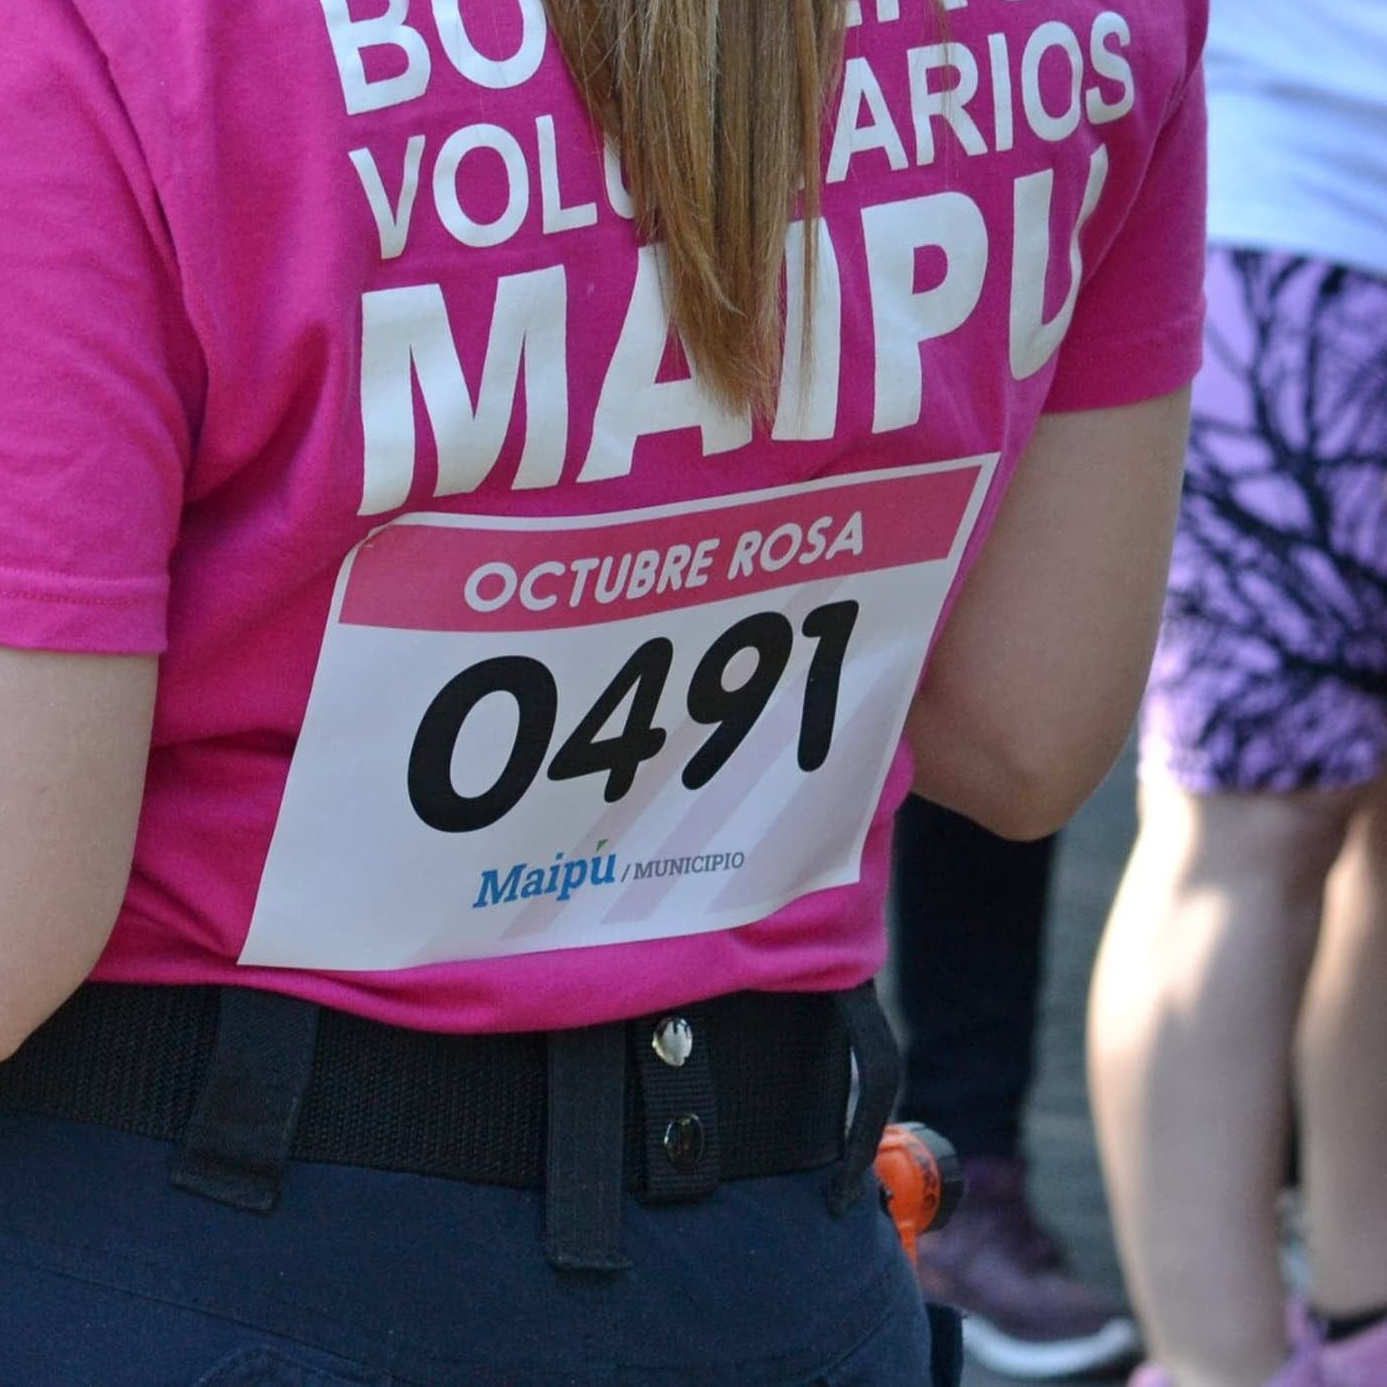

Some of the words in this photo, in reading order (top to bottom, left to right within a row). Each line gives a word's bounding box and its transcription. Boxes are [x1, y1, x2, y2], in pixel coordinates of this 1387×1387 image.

[350, 10, 1133, 260] VOLARIOS
[463, 537, 719, 613] OCTUBRE
[728, 511, 864, 581] ROSA
[407, 599, 860, 833] 0491
[472, 838, 617, 909] Maipú
[633, 850, 745, 880] MUNICIPIO
